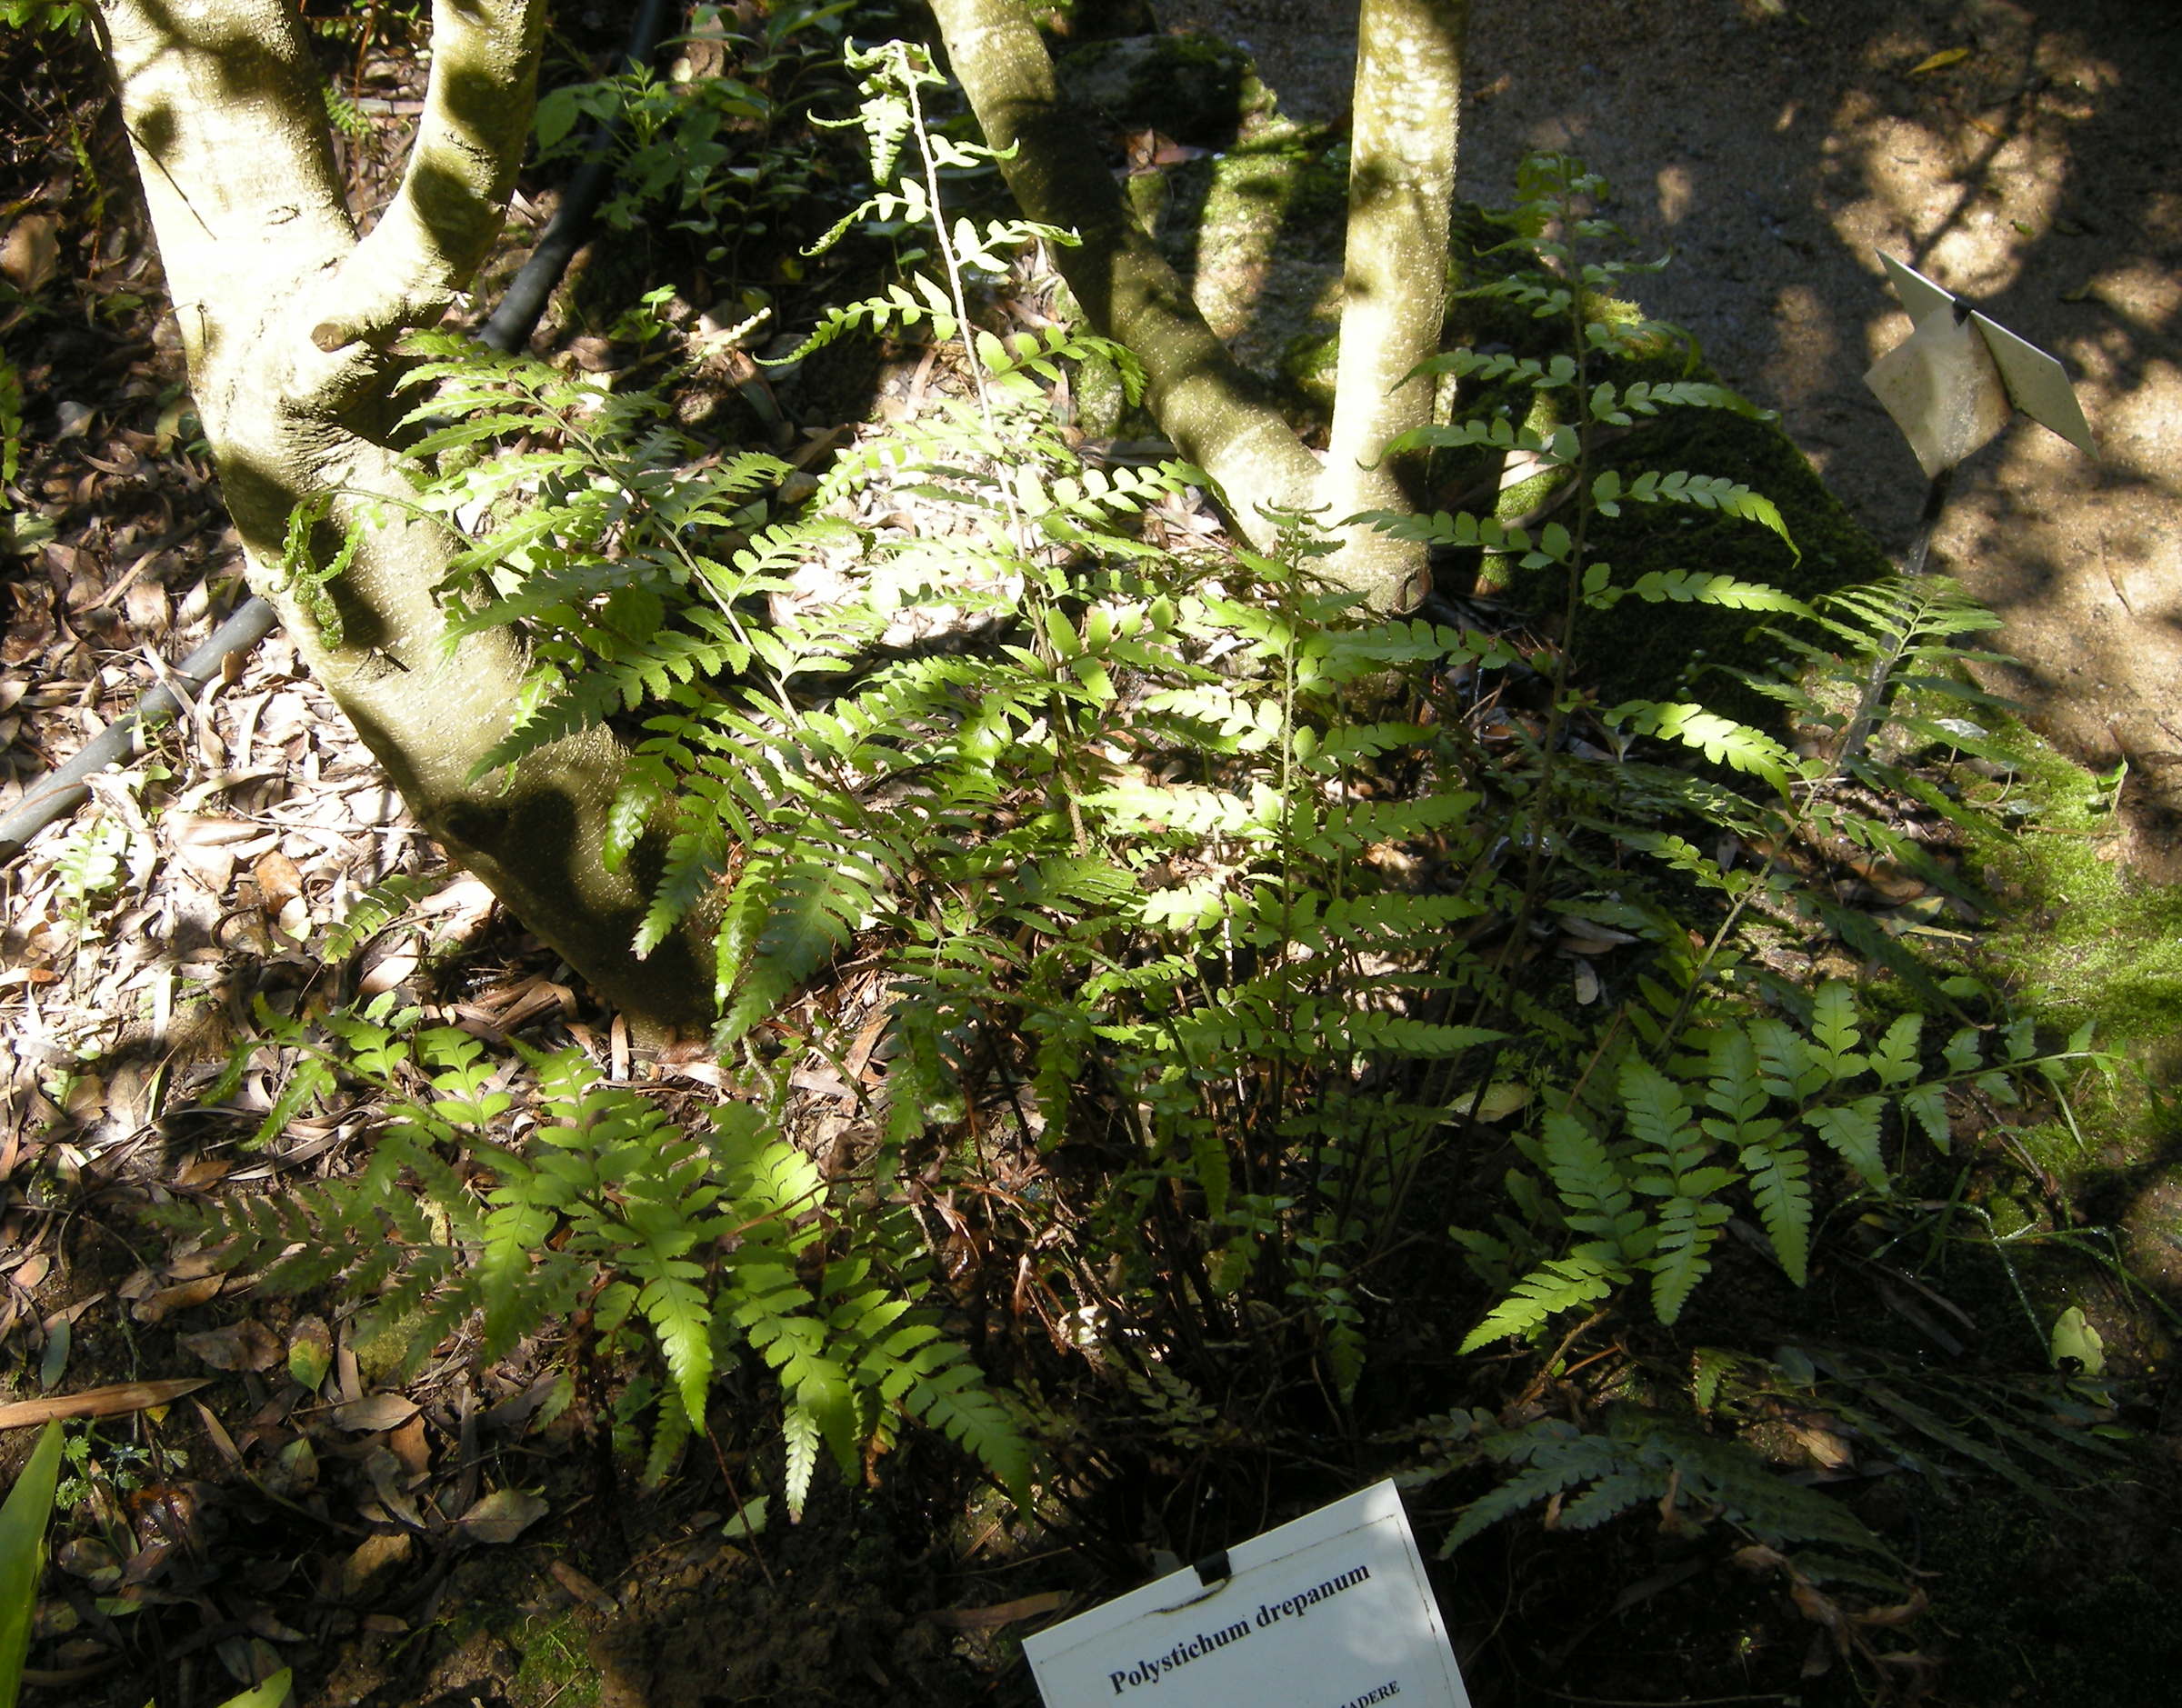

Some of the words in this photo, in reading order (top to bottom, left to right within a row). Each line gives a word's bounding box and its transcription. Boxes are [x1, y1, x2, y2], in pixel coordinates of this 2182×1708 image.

[1108, 1619, 1251, 1695] Polystichum
[1256, 1564, 1371, 1628] drepanum
[1340, 1680, 1400, 1708] ADERE
